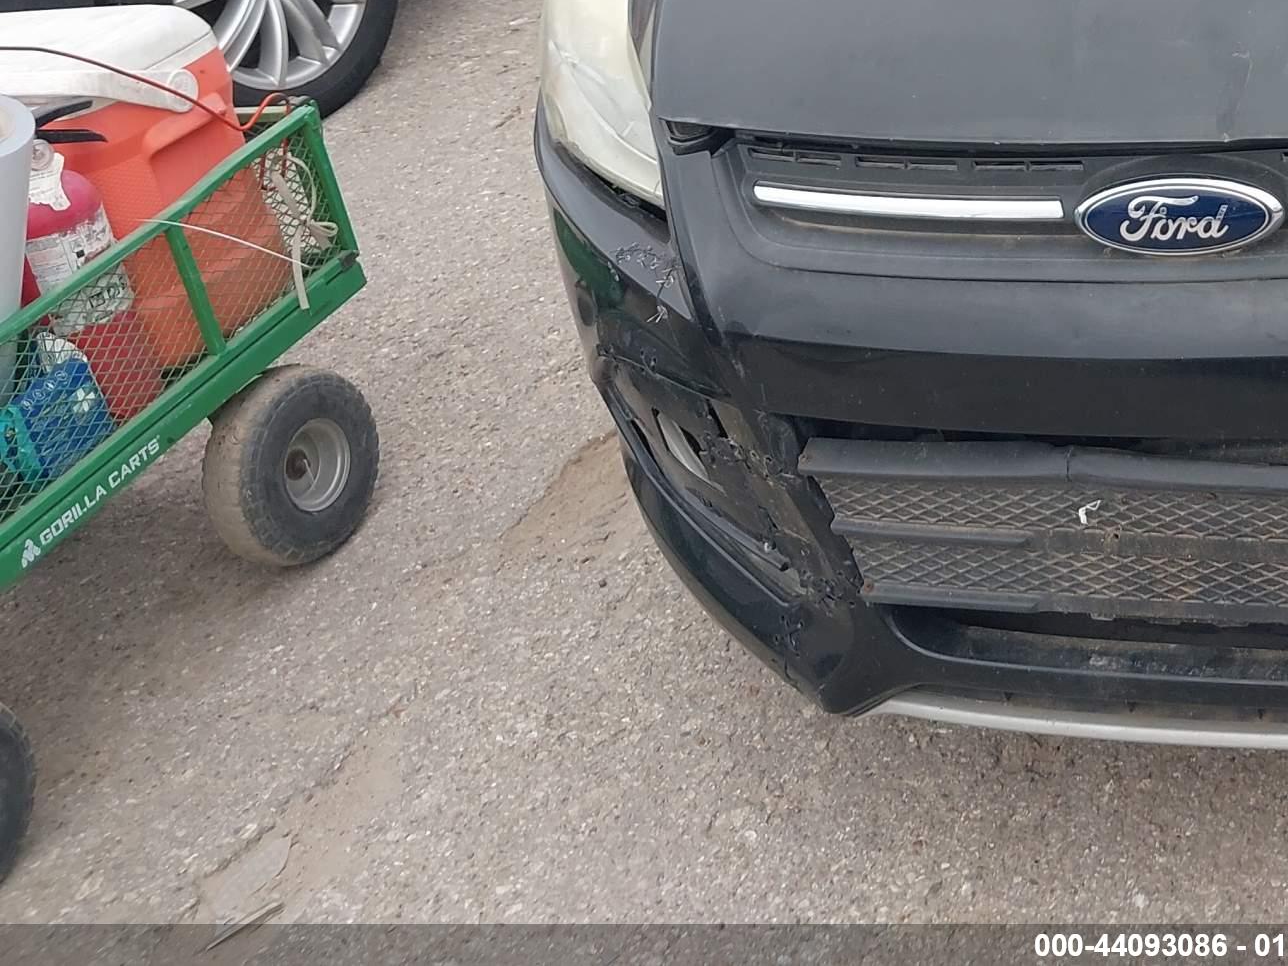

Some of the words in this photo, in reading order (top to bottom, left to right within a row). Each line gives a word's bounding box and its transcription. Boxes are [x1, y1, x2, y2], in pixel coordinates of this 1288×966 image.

[1119, 194, 1230, 242] Ford
[39, 484, 108, 545] GORILLA
[107, 438, 161, 489] CARTS
